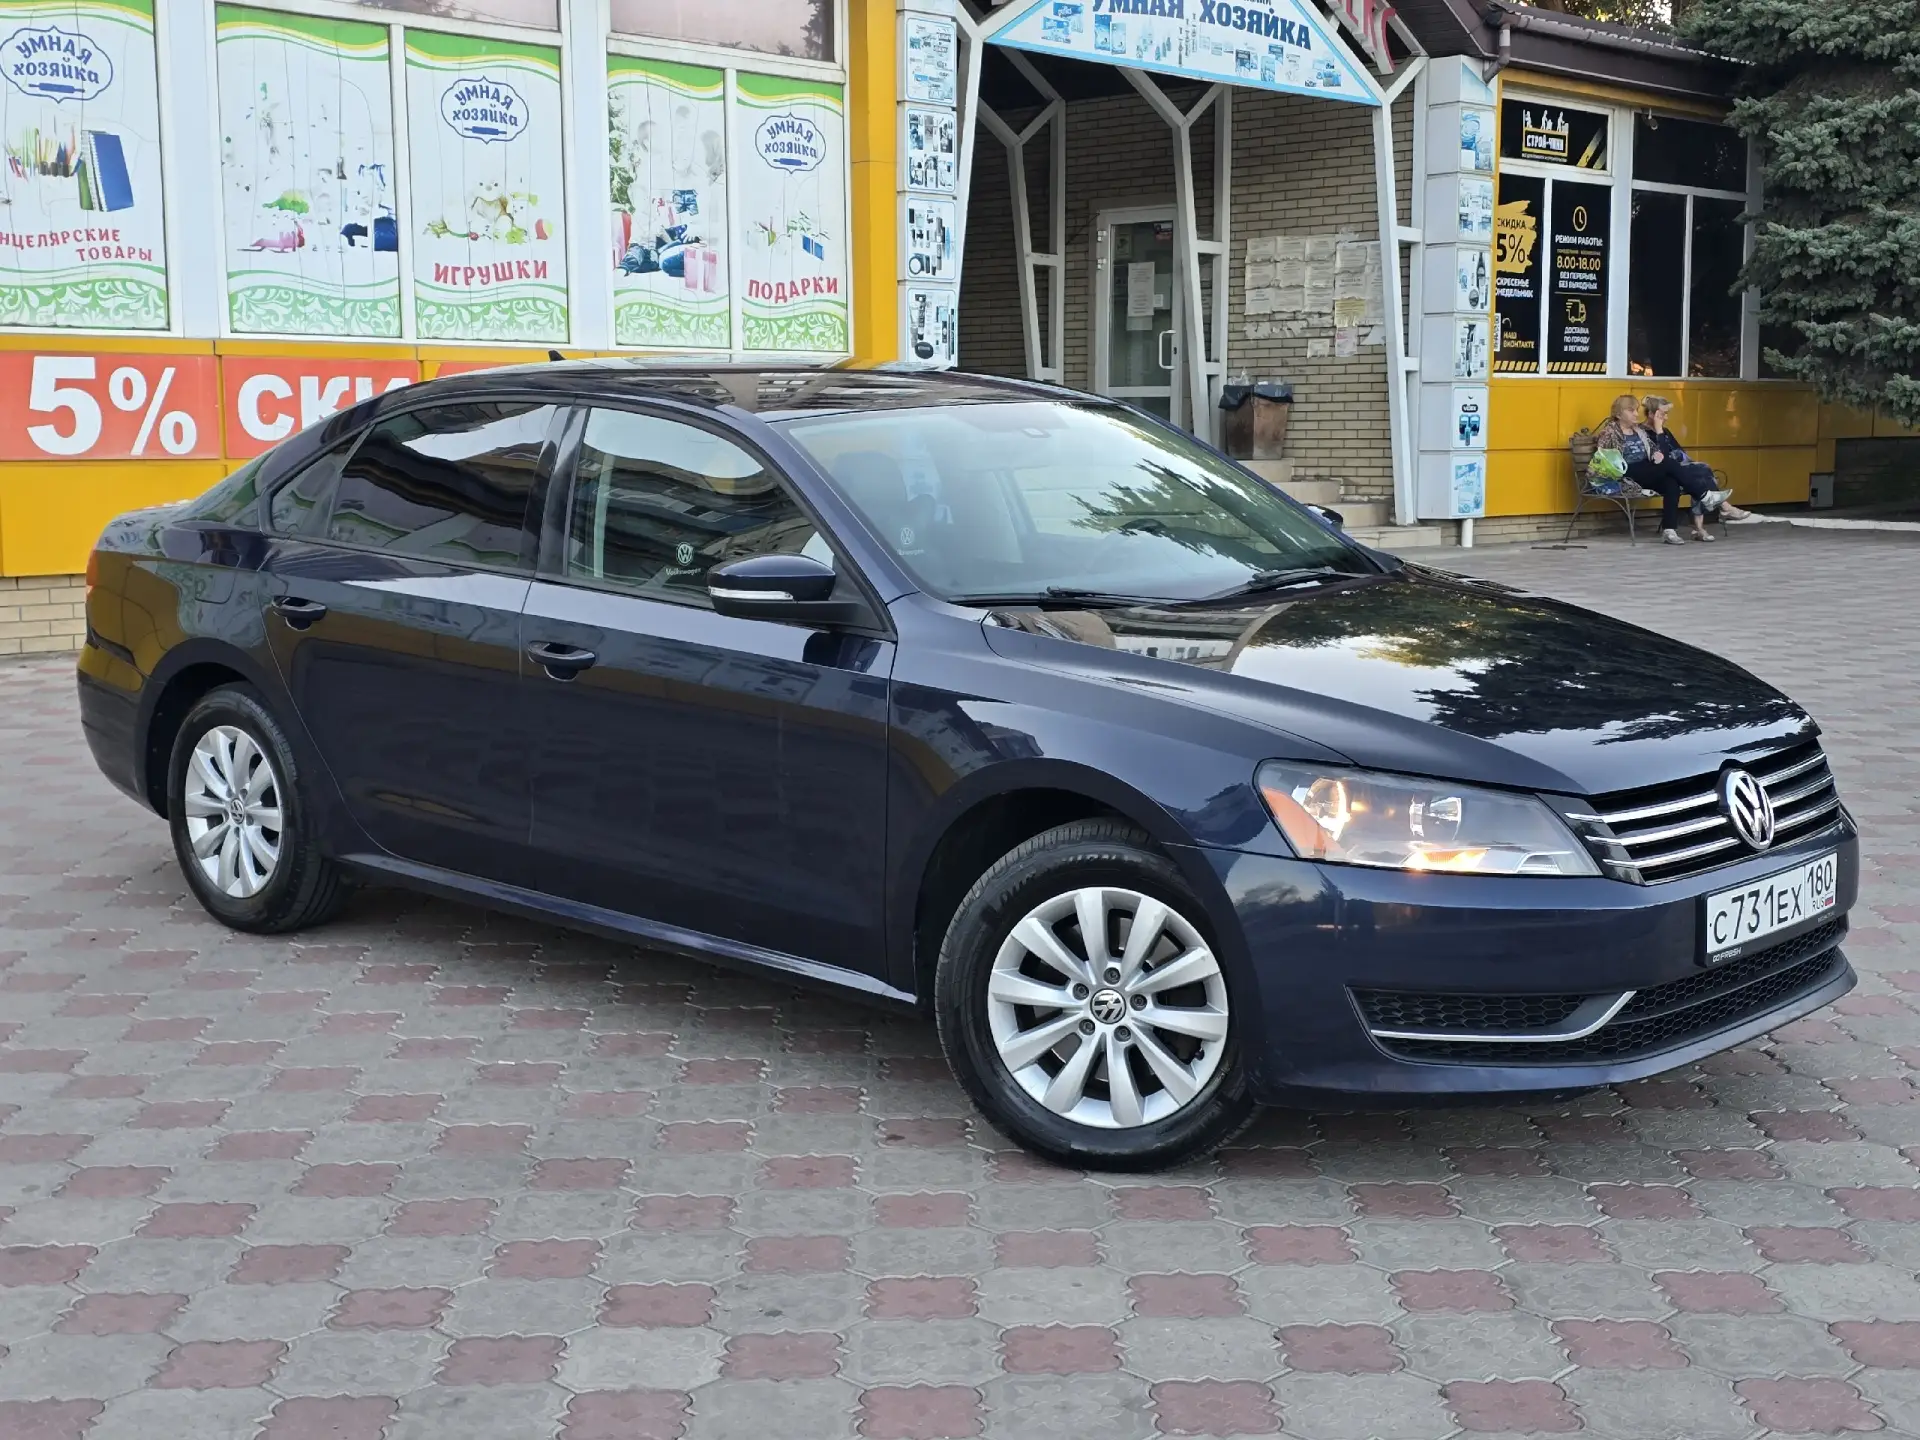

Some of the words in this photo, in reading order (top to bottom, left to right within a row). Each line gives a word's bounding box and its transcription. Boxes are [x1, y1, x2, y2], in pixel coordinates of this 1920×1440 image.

[1199, 0, 1312, 51] ХОЗЯЙКА
[16, 34, 92, 65] УМНАЯ
[454, 84, 514, 111] УМНАЯ
[766, 120, 814, 143] УМНАЯ
[75, 245, 153, 262] ТОВАРЫ
[1496, 233, 1526, 264] 5%
[434, 260, 547, 286] ИГРУШКИ
[1556, 256, 1601, 271] 8.00-18.00
[748, 276, 838, 304] ПОДАРКИ
[27, 355, 198, 456] 5%
[1713, 884, 1802, 944] С731ЕХ
[1807, 860, 1833, 898] 180
